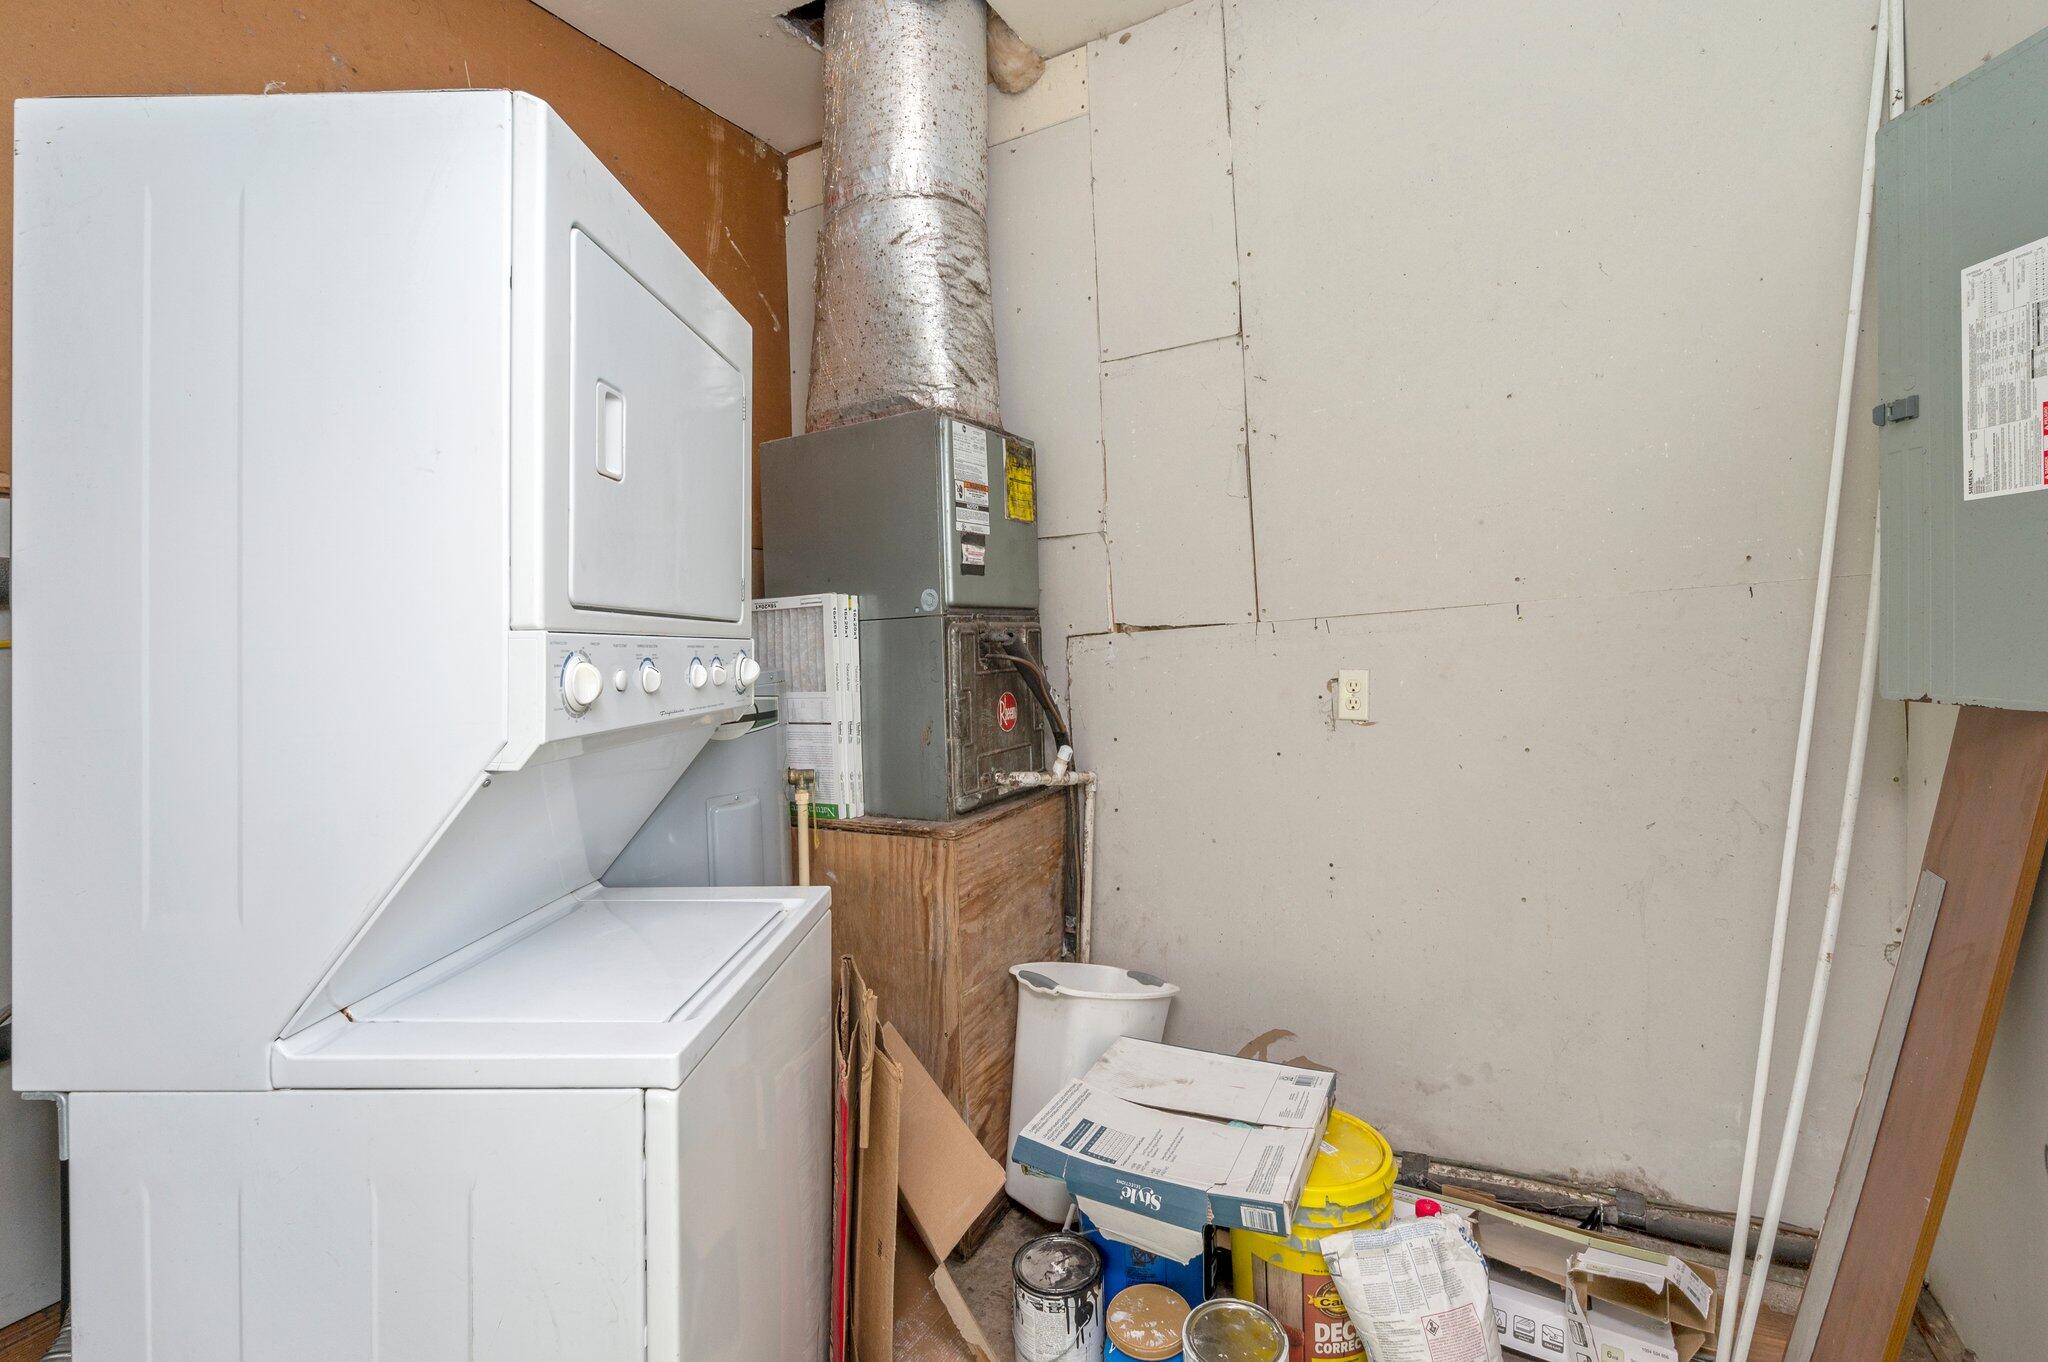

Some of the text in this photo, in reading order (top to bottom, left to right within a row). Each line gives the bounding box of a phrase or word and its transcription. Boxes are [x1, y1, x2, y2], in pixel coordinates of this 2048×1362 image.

[1116, 1178, 1141, 1190] SELECTIONS
[1120, 1185, 1162, 1212] Style
[1314, 1321, 1356, 1343] DEC
[1314, 1336, 1363, 1354] CORREC
